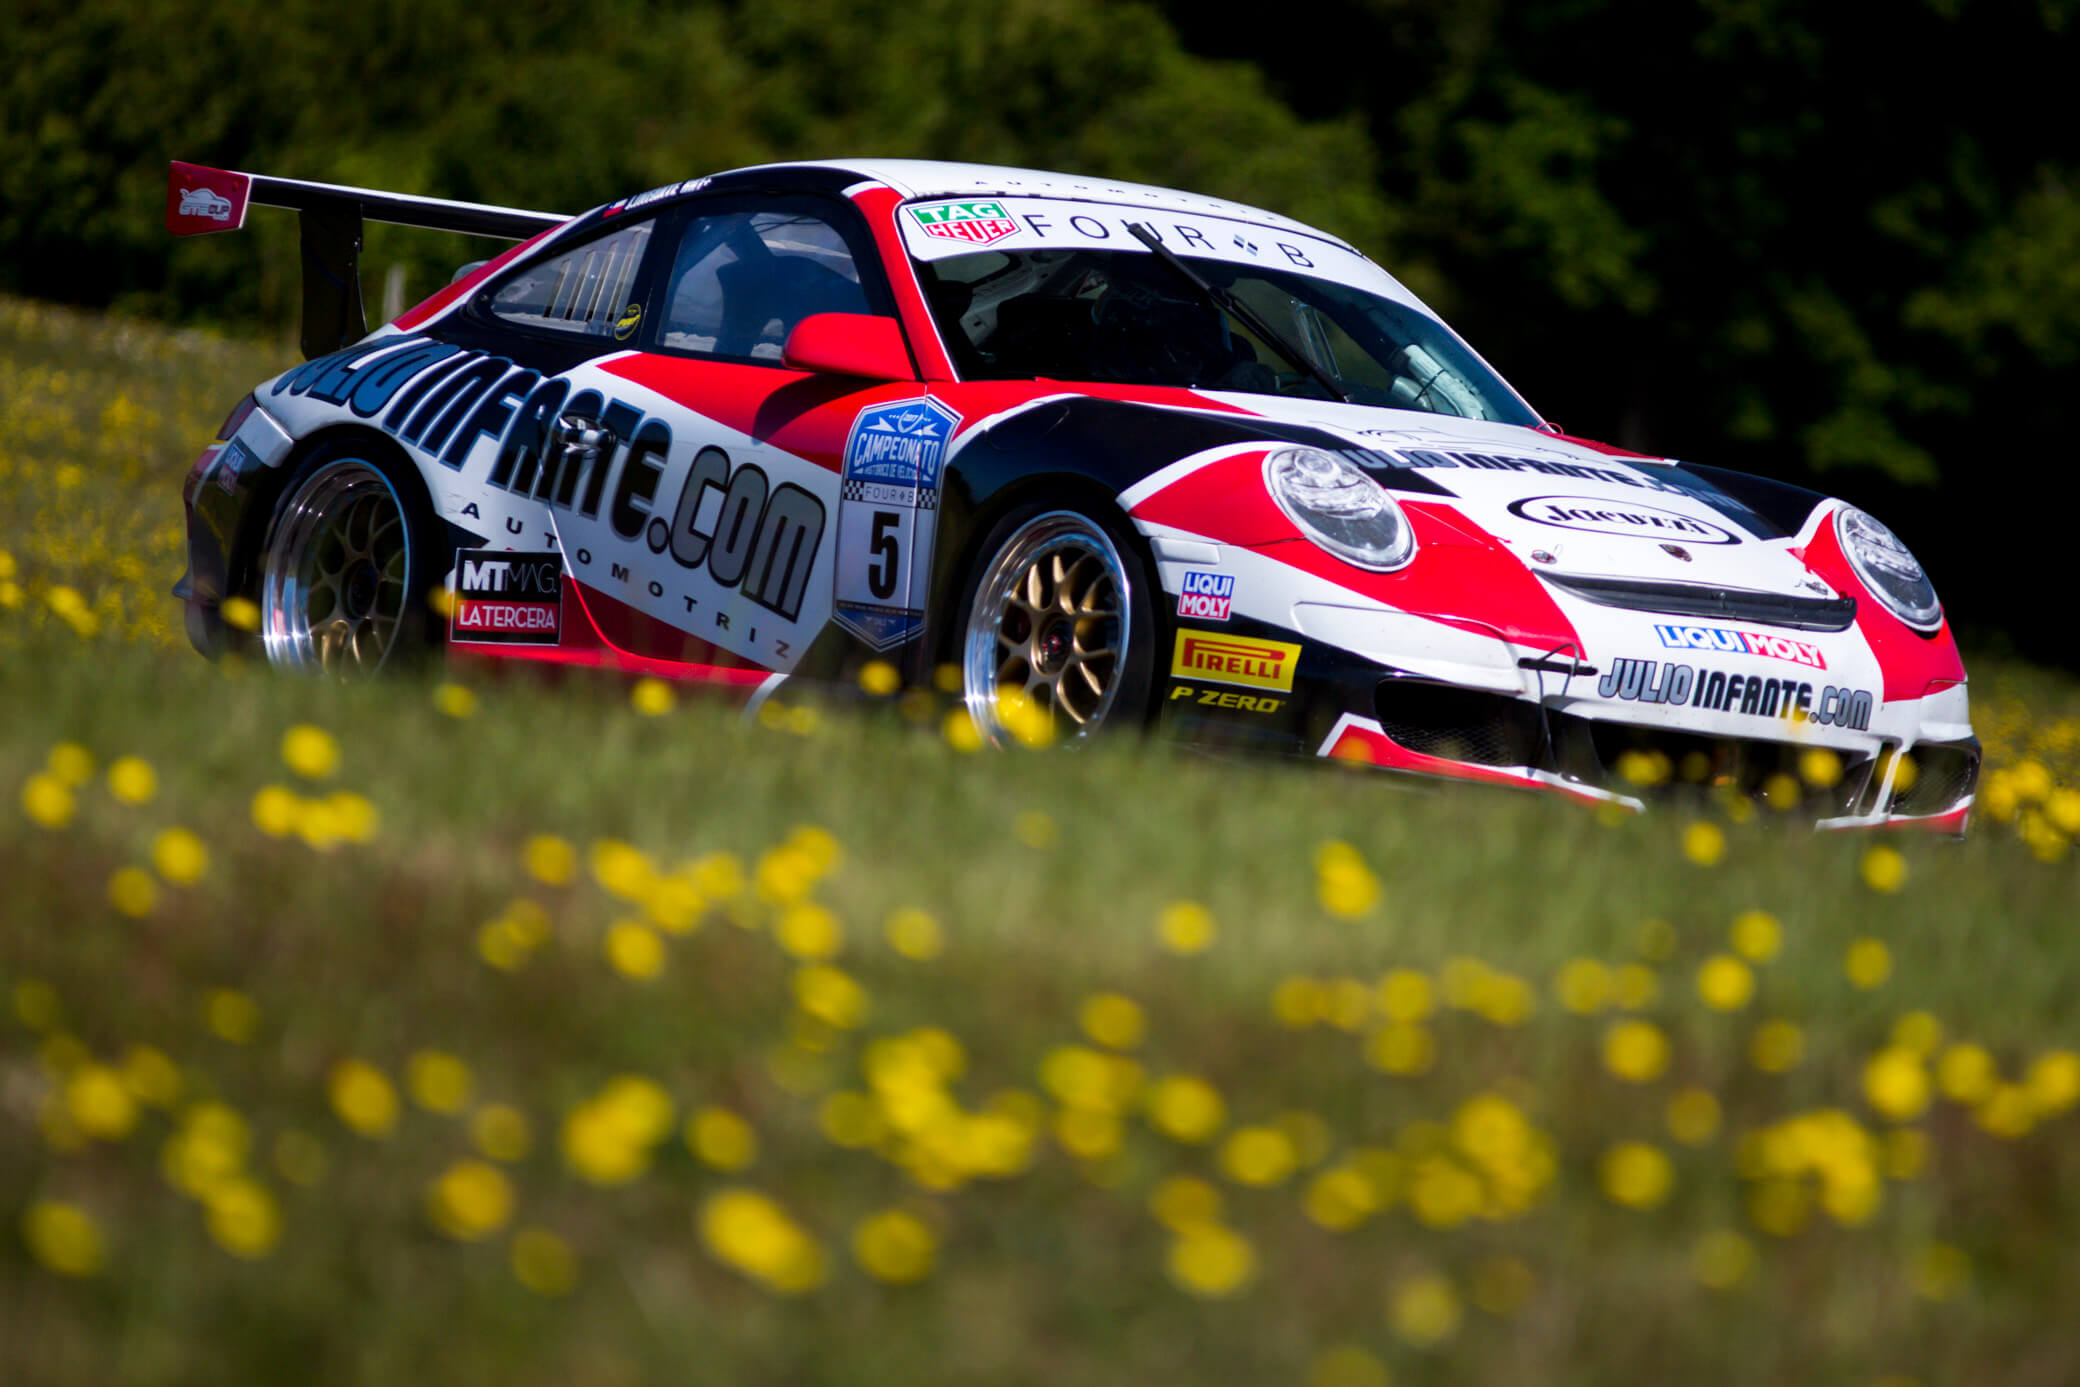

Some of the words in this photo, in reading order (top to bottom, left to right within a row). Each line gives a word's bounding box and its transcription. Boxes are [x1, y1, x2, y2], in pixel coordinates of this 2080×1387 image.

[917, 203, 1000, 222] TAG
[927, 220, 1012, 244] HEUER
[1276, 241, 1315, 269] B
[853, 432, 940, 476] CAMPEONATO
[864, 486, 897, 500] FOUR
[868, 510, 901, 600] 5
[460, 501, 791, 660] AUTOMOTRIZ
[1184, 573, 1233, 597] LIQUI
[1180, 595, 1230, 618] MOLY
[1181, 637, 1286, 680] PIRELLI
[1656, 625, 1747, 652] LIQUI
[1748, 632, 1822, 669] MOLY
[1170, 686, 1194, 700] P
[1197, 690, 1281, 713] ZERO
